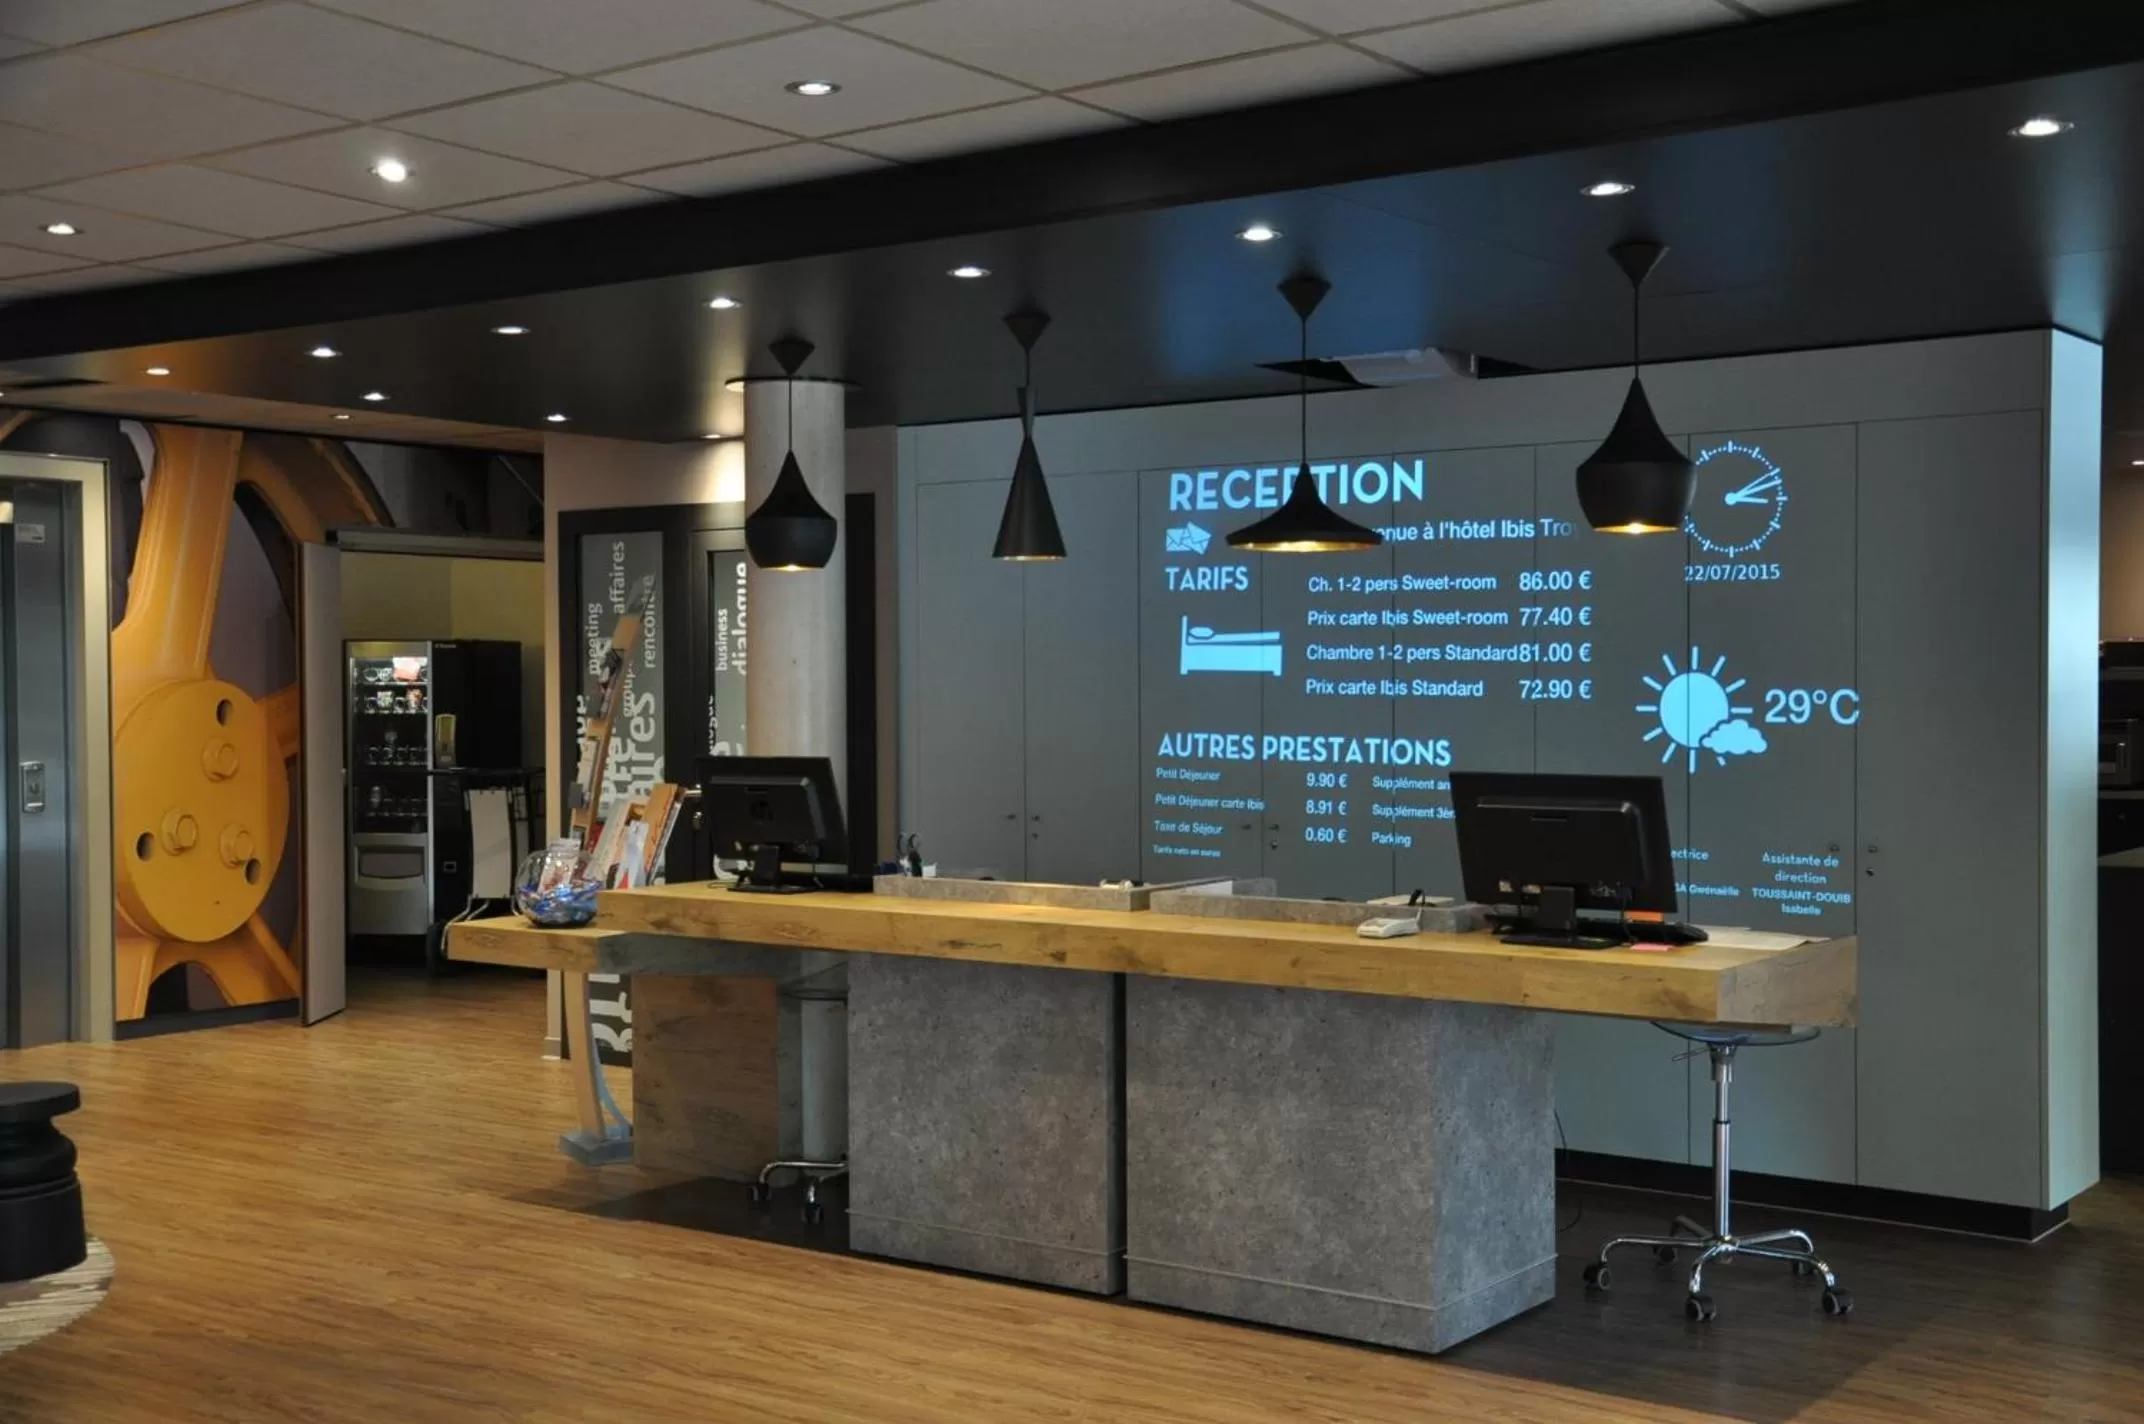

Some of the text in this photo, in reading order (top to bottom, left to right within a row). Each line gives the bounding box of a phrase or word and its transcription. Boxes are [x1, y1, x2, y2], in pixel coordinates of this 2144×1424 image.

[1423, 521, 1434, 540] à
[1439, 520, 1495, 539] l'hôtel
[1501, 519, 1535, 538] Ibis
[1539, 518, 1579, 537] Tro
[609, 541, 624, 613] affaires
[1165, 566, 1248, 591] TARIFS
[1308, 571, 1591, 596] Ch. 1-2 pers Sweet-room 86.00 €
[1684, 563, 1780, 582] 22/07/2015
[1307, 606, 1591, 626] Prix carte Ibis Sweet-room 77.40 €
[715, 609, 727, 671] business
[1306, 643, 1591, 663] Chambre 1-2 pers Standard 81.00 €
[1306, 678, 1591, 699] Prix carte Ibis Standard 72.90 €
[1765, 688, 1859, 725] 29°C
[1158, 733, 1452, 768] AUTRES PRESTATIONS
[1156, 768, 1177, 778] Petit
[1179, 768, 1220, 782] Déjeuner
[1306, 773, 1336, 788] 9.90
[1338, 774, 1348, 788] €
[1372, 776, 1434, 789] Supplément
[1155, 793, 1176, 804] Petit
[1178, 795, 1220, 808] Déjeuner
[1221, 799, 1244, 808] carte
[1247, 799, 1265, 810] Ibis
[1306, 801, 1332, 816] 8.91
[1338, 801, 1348, 816] €
[1372, 804, 1434, 818] Supplément
[1178, 822, 1189, 832] de
[1192, 822, 1223, 835] Séjour
[1305, 828, 1335, 842] 0.60
[1338, 829, 1347, 843] €
[1372, 832, 1412, 848] Parking
[1671, 848, 1709, 860] ectrice
[1762, 851, 1839, 867] Assistante de
[1774, 871, 1826, 883] direction
